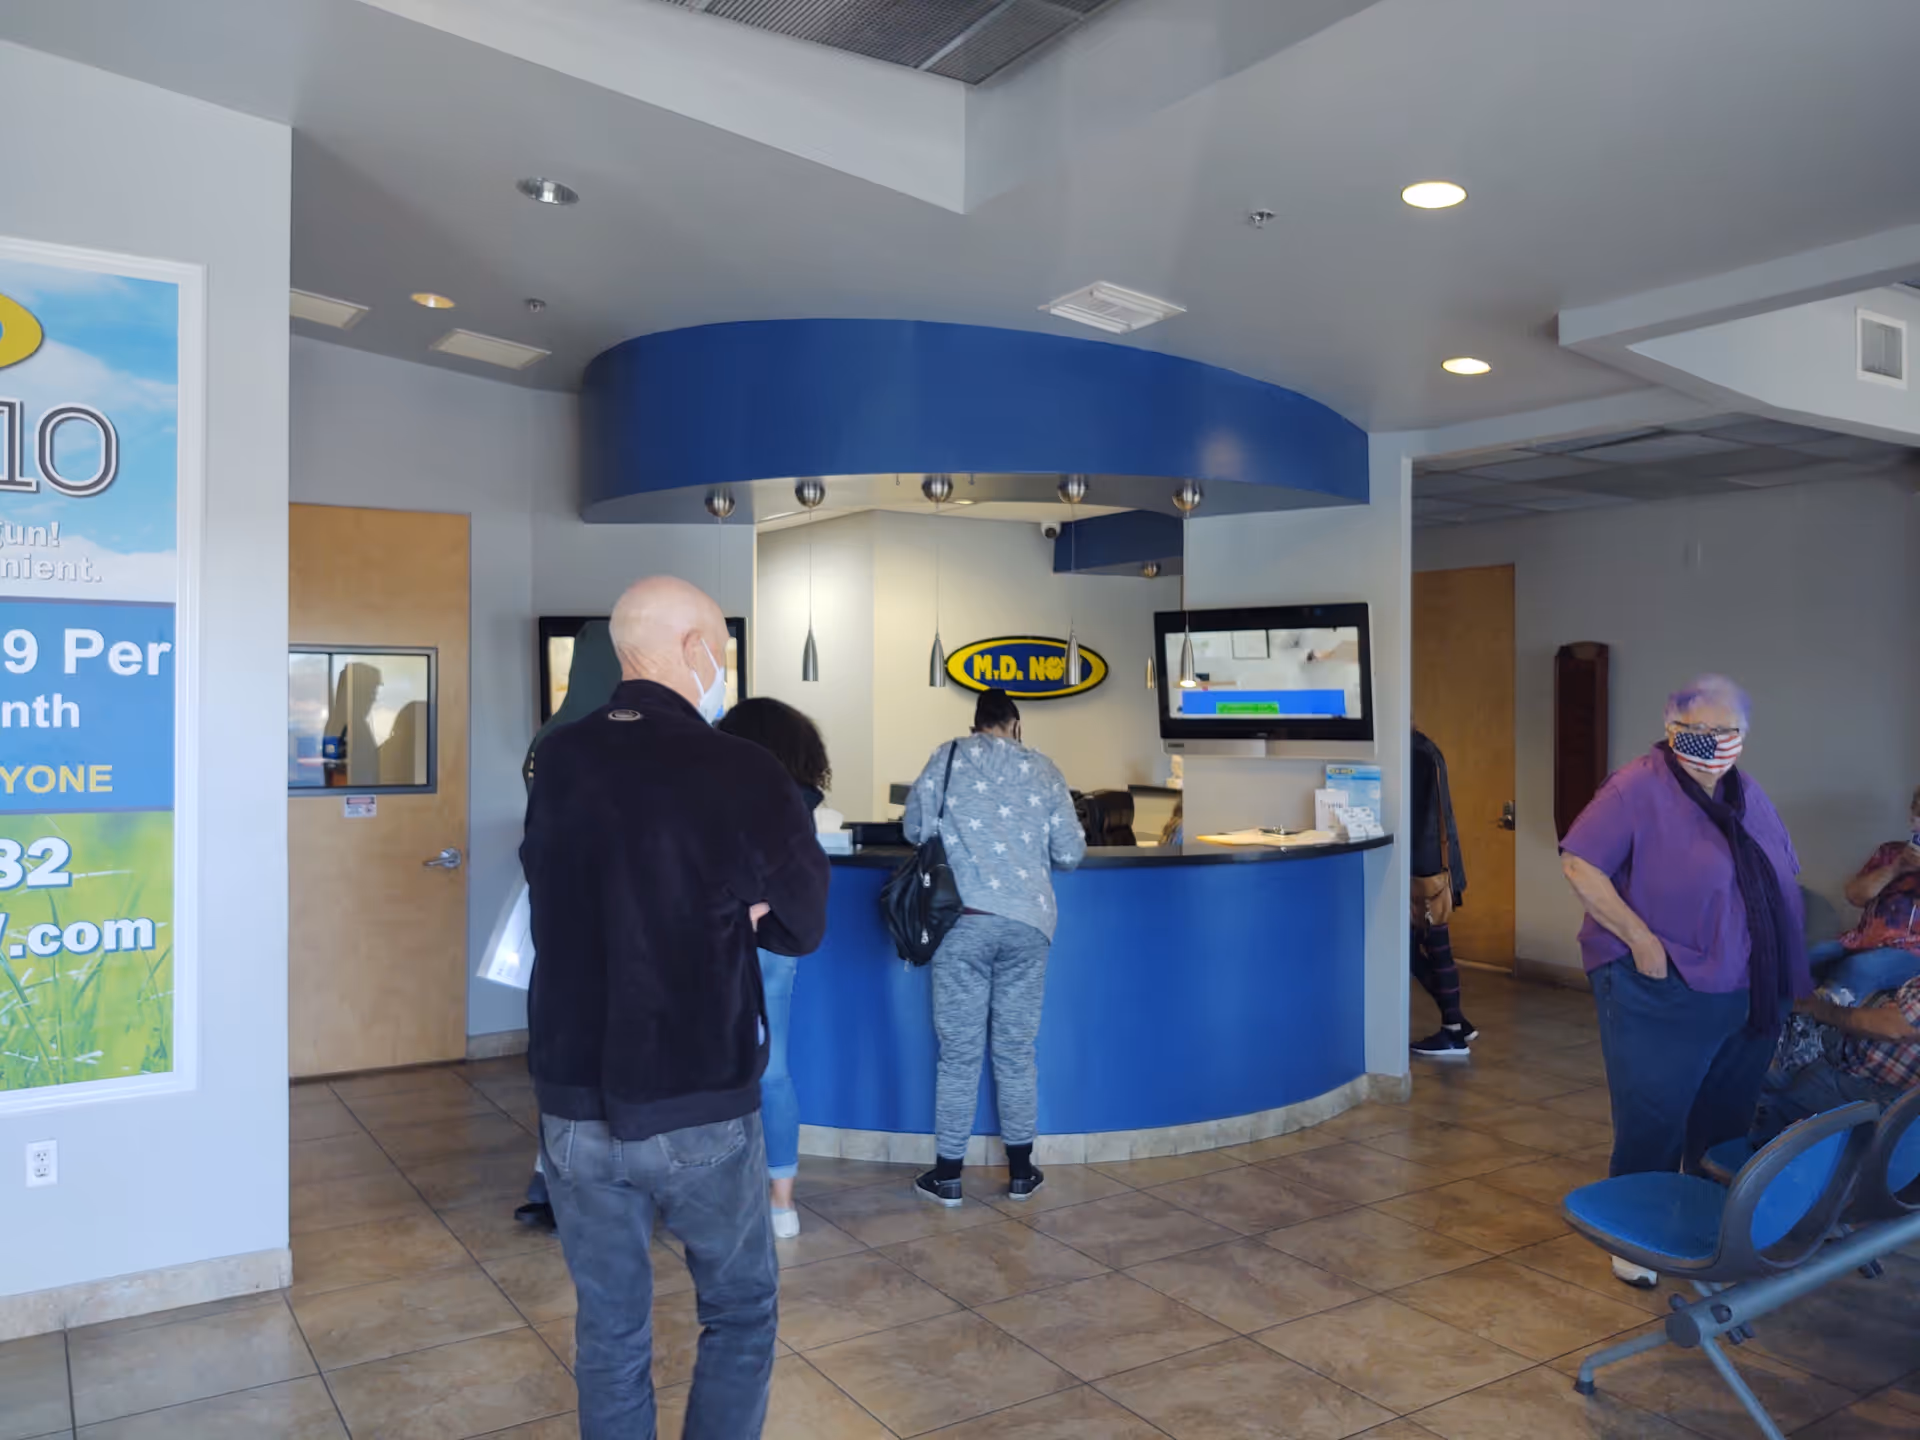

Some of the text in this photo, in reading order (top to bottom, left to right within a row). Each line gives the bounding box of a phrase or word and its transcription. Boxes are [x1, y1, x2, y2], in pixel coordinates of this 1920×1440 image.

[0, 396, 119, 498] 10
[0, 520, 60, 549] un!
[0, 553, 102, 583] nient.
[3, 628, 172, 676] 9 Per
[1029, 656, 1081, 681] NO
[2, 693, 80, 728] nth
[0, 765, 113, 793] YONE
[0, 912, 156, 959] .com
